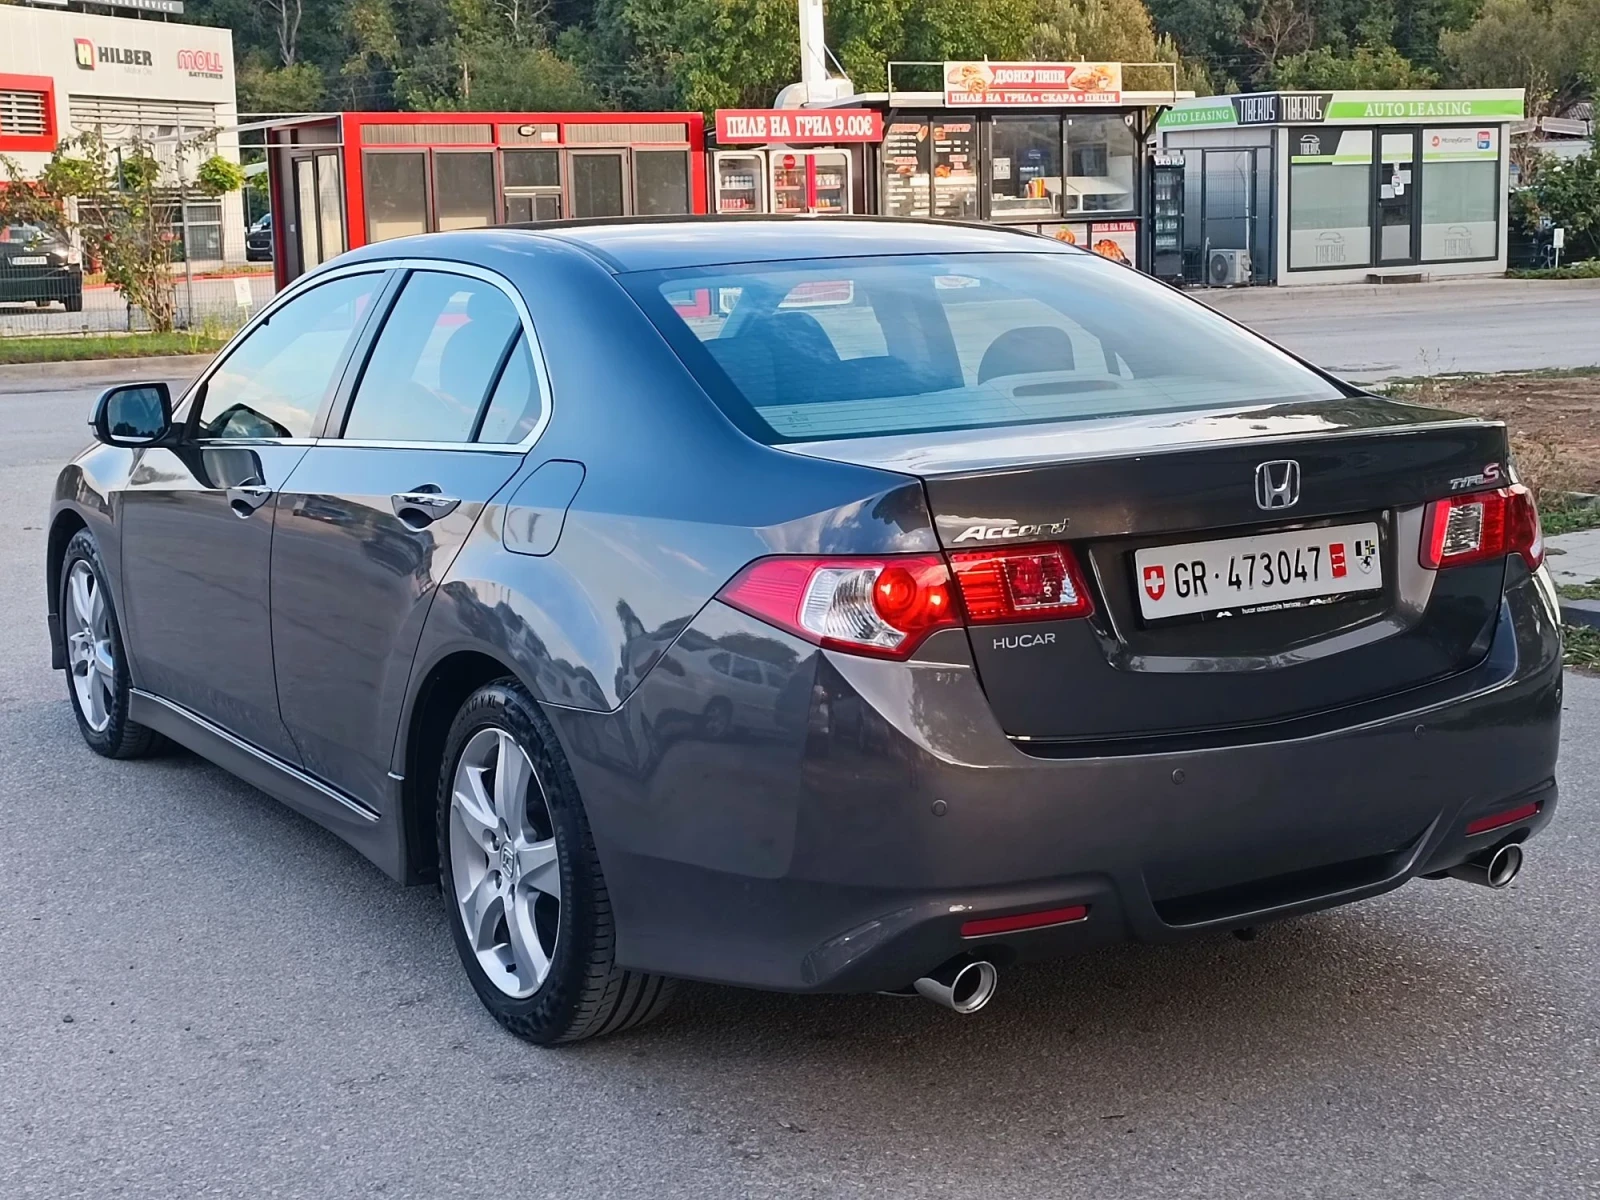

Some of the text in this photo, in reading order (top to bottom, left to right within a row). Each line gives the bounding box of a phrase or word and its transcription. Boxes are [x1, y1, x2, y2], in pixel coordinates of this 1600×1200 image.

[98, 47, 153, 66] HILBER
[188, 71, 224, 79] BATTERIES
[994, 69, 1034, 85] ДОНЕР
[951, 92, 983, 103] ПИЛЕ
[985, 92, 1002, 103] НА
[1004, 92, 1034, 103] ГРИЛ
[1041, 93, 1077, 103] СКАРА
[1164, 109, 1229, 124] AUTO LEASING
[1240, 97, 1276, 122] TIBERUS
[1281, 96, 1323, 120] TIBERUS
[1364, 101, 1472, 117] AUTO LEASING
[726, 116, 767, 137] ПИЛЕ
[769, 116, 791, 137] НА
[795, 116, 833, 137] ГРИЛ
[1315, 244, 1346, 264] TIBERUS
[952, 518, 1070, 543] Accord
[1174, 545, 1321, 598] GR 473047
[993, 633, 1056, 649] HUCAR
